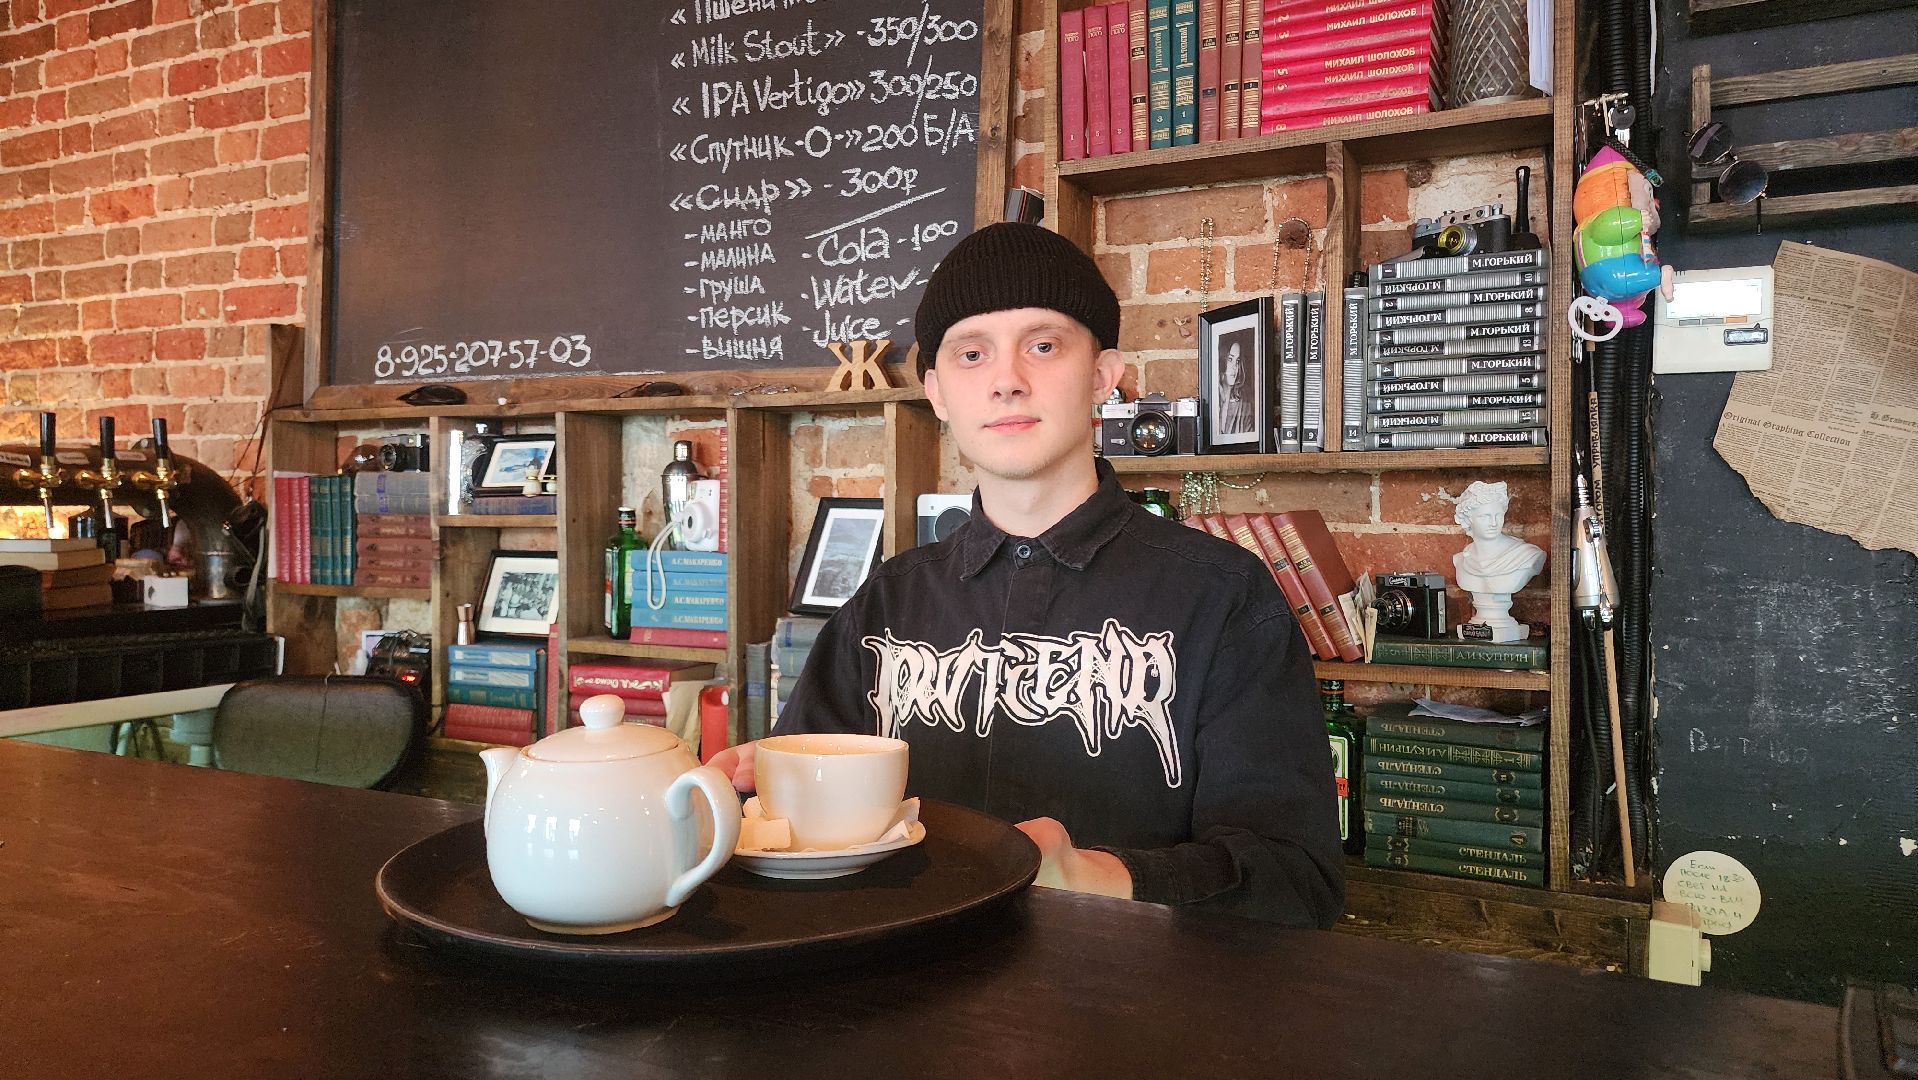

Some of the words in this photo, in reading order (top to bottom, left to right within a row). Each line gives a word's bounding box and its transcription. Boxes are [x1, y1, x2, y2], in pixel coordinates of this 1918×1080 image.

[1326, 17, 1365, 31] МИХАИЛ
[1369, 8, 1417, 24] ШОЛОХОВ
[1278, 31, 1290, 40] 3
[1324, 55, 1365, 69] МИХАИЛ
[1367, 47, 1415, 62] ШОЛОХОВ
[1324, 71, 1364, 84] МИХАИЛ
[1367, 62, 1414, 78] ШОЛОХОВ
[1323, 114, 1362, 126] МИХАИЛ
[1365, 106, 1414, 120] ШОЛОХОВ
[1472, 254, 1534, 269] М.ГОРЬКИЙ
[1524, 273, 1533, 282] 10
[1384, 281, 1442, 295] М.ГОРЬКИЙ
[1473, 288, 1534, 303] М.ГОРЬКИЙ
[1385, 312, 1442, 325] М.ГОРЬКИЙ
[1285, 307, 1295, 359] М.ГОРЬКИЙ
[1310, 307, 1319, 360] М.ГОРЬКИЙ
[1349, 302, 1358, 356] М.ГОРЬКИЙ
[1470, 323, 1531, 337] М.ГОРЬКИЙ
[1382, 343, 1440, 357] М.ГОРЬКИЙ
[1523, 338, 1532, 348] 13
[374, 334, 593, 378] 8-925-207-57-03
[1471, 356, 1532, 369] М.ГОРЬКИЙ
[824, 340, 891, 392] Ж
[1382, 381, 1440, 394] М.ГОРЬКИЙ
[1522, 376, 1531, 384] 5
[1472, 394, 1533, 405] М.ГОРЬКИЙ
[1382, 415, 1440, 428] М.ГОРЬКИЙ
[1522, 411, 1531, 421] 15
[1286, 430, 1293, 438] 6
[1723, 411, 1761, 427] Original
[1806, 430, 1851, 447] Collection
[1469, 432, 1529, 443] М.ГОРЬКИЙ
[1381, 723, 1446, 737] СТЕНДАЛЬ
[1377, 761, 1442, 776] СТЕНДАЛЬ
[1380, 779, 1445, 795] СТЕНДАЛЬ
[1379, 797, 1445, 813] СТЕНДАЛЬ
[1458, 847, 1527, 864] СТЕНДАЛЬ
[1458, 864, 1527, 881] СТЕНДАЛЬ
